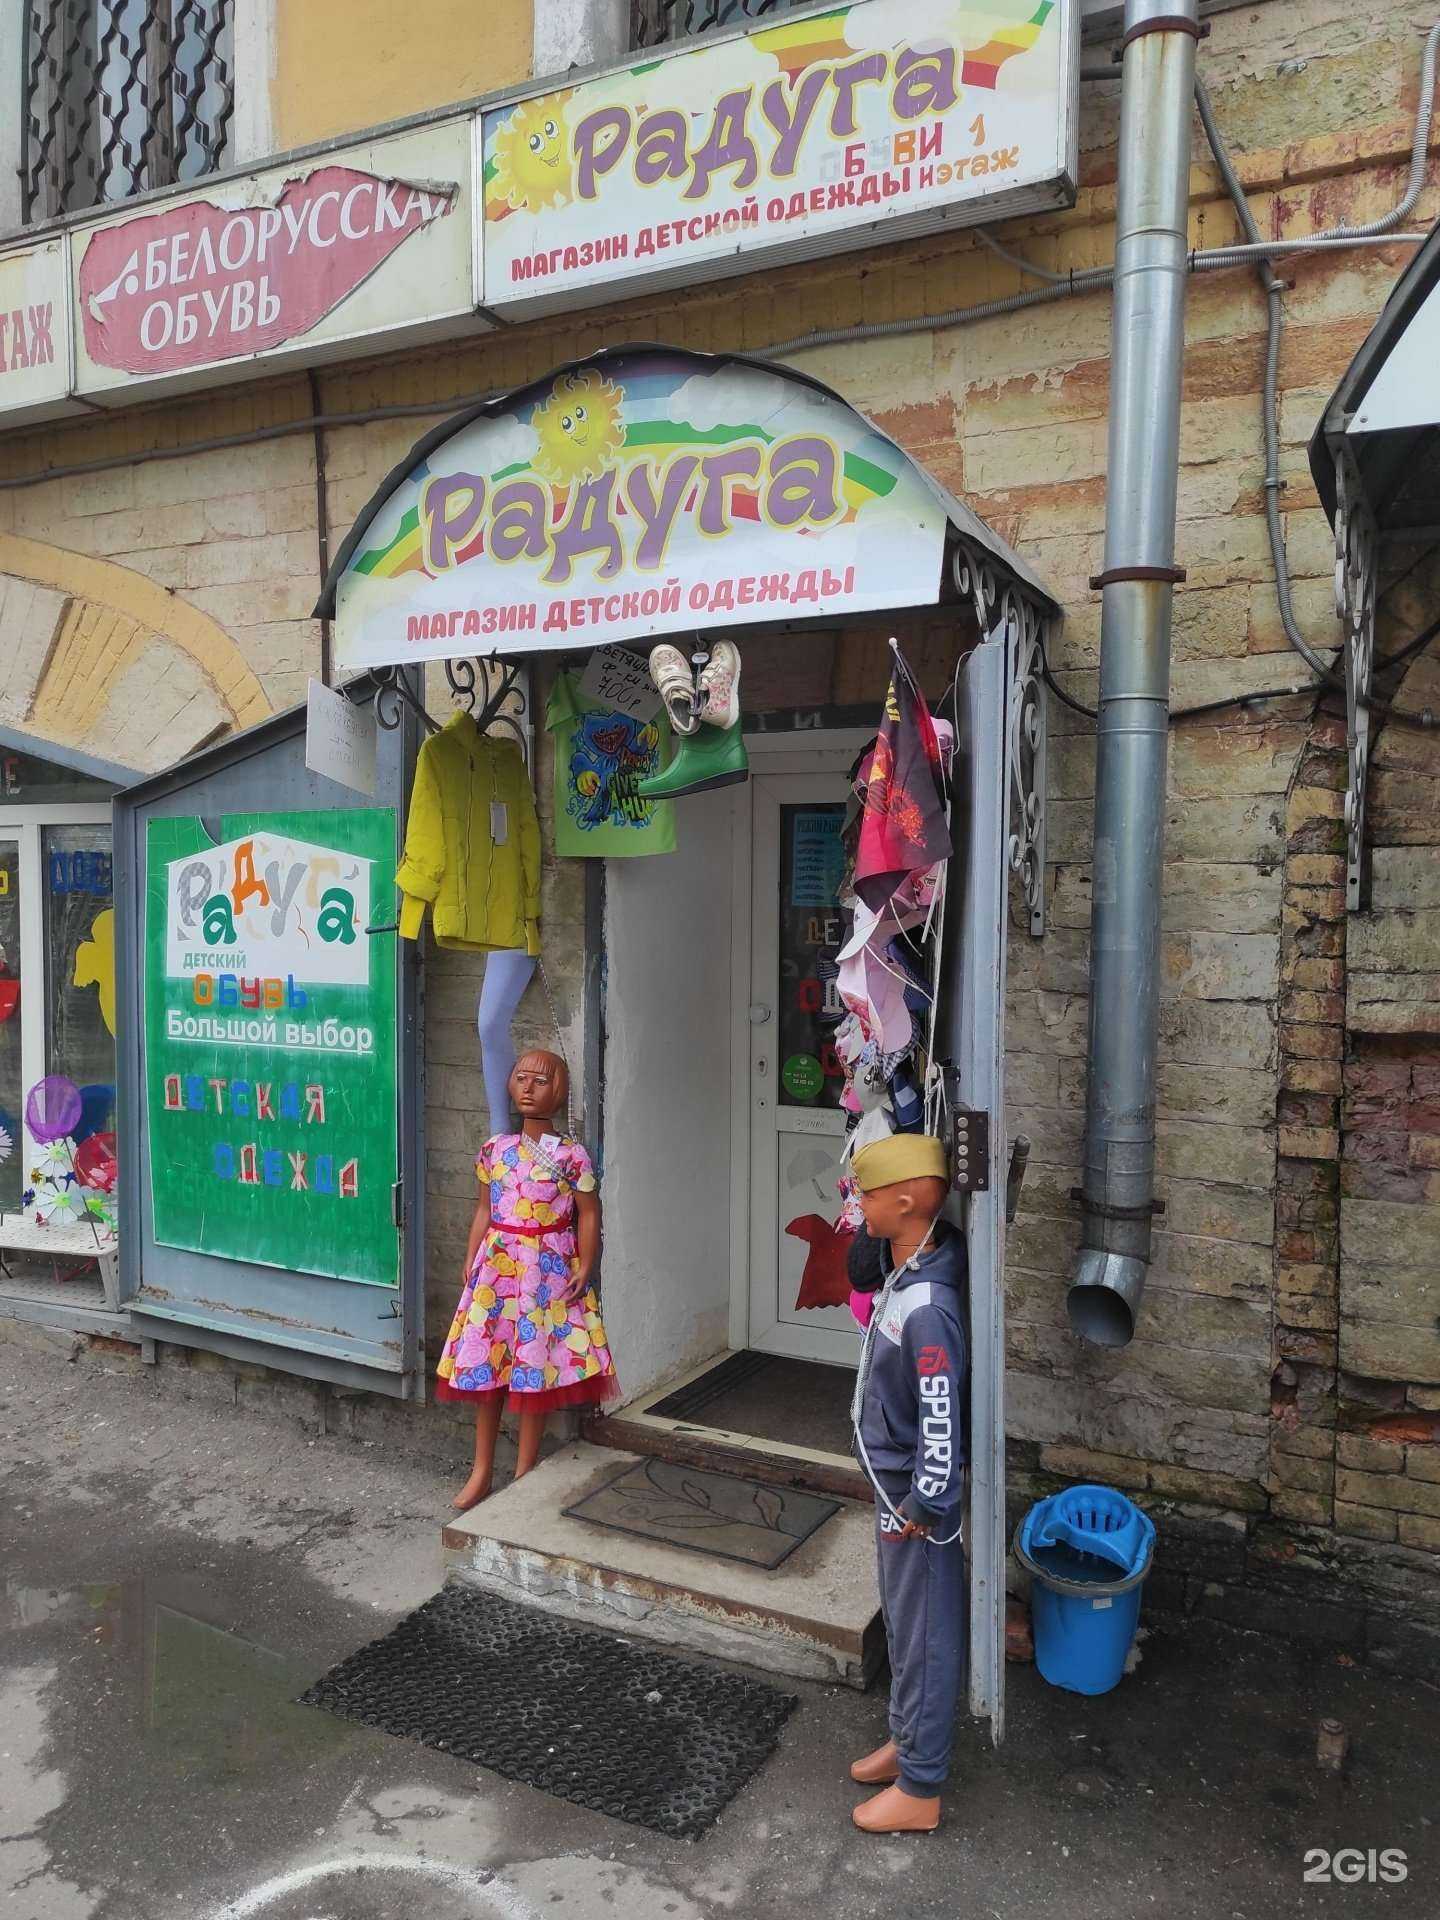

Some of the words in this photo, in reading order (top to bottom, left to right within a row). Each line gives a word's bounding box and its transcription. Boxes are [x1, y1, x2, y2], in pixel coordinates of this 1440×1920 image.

[145, 182, 449, 292] БЕЛОРУССКА
[511, 234, 628, 282] МАГАЗИН
[634, 196, 760, 258] ДЕТСКОЙ
[766, 166, 911, 224] ОДЕЖДЫ
[140, 275, 281, 351] ОБУВЬ
[406, 604, 536, 642] МАГАЗИН
[542, 576, 680, 635] ДЕТСКОЙ
[689, 565, 855, 613] ОДЕЖДЫ
[183, 949, 247, 971] ДЕТСКИЙ
[193, 973, 307, 1009] ОБУВЬ
[168, 1009, 276, 1044] Большой
[286, 1017, 373, 1051] выбор
[164, 1073, 326, 1124] ДЕТСКАЯ
[213, 1142, 358, 1198] ОДЕЖДА
[919, 1375, 952, 1498] SPORTS
